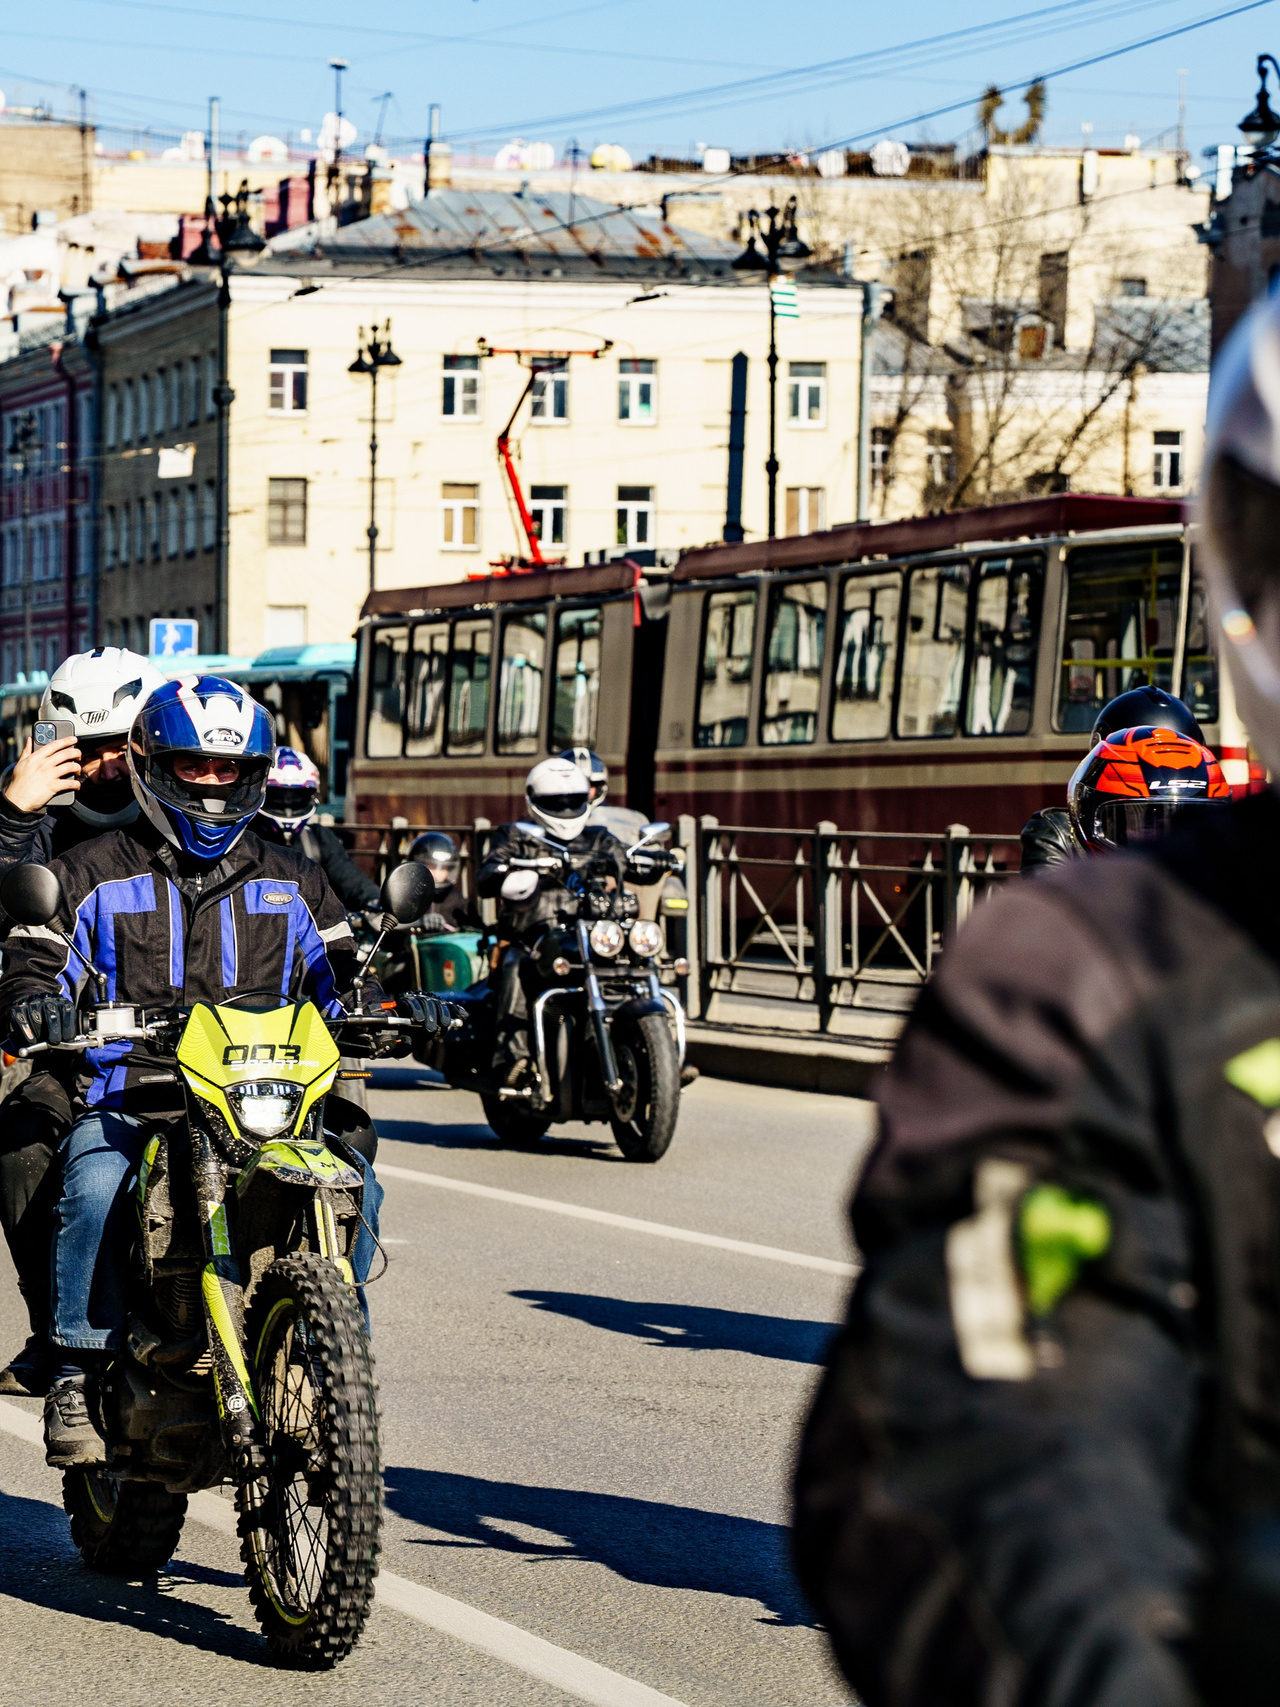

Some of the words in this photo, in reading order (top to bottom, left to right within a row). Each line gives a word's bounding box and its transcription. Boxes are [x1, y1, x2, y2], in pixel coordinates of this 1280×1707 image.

[1149, 779, 1207, 790] LS2
[222, 1044, 301, 1065] 003
[230, 1059, 298, 1071] SPORT
